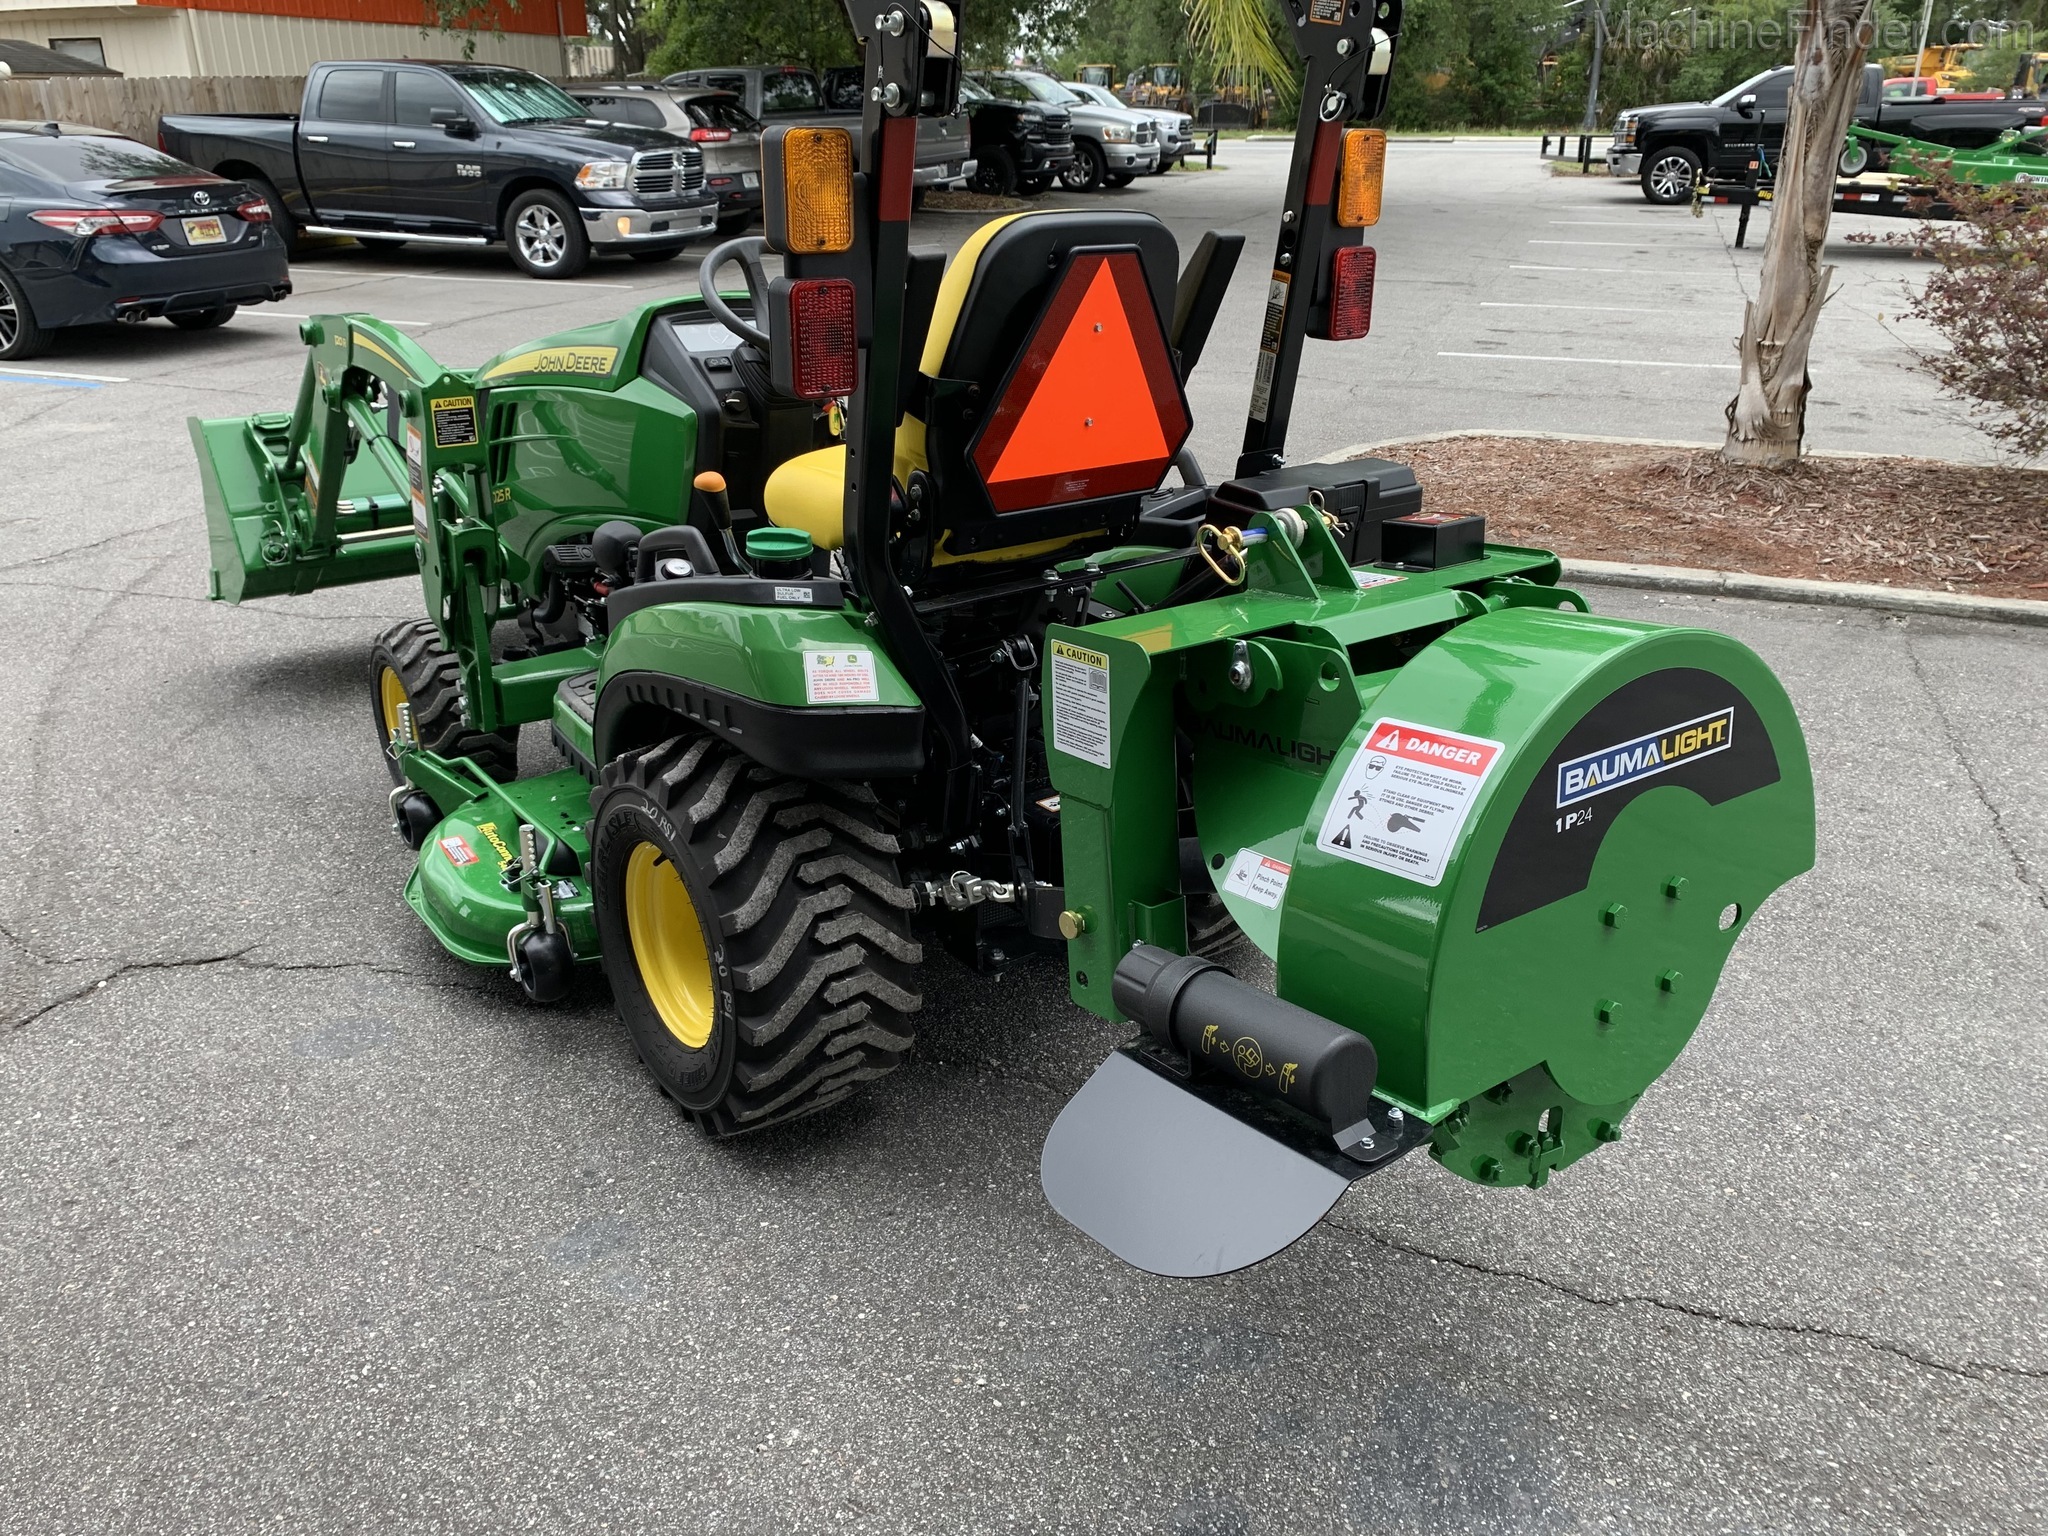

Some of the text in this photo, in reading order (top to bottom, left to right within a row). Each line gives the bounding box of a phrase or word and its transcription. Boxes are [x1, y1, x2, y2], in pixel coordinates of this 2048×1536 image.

[1757, 190, 1773, 200] Big
[534, 352, 608, 372] JOHN DEERE
[443, 398, 472, 408] CAUTION
[1066, 647, 1102, 667] CAUTION
[1186, 714, 1337, 766] BAUMALIGH
[1405, 737, 1483, 766] DANGER
[1565, 719, 1727, 796] BAUMALIGHT
[640, 797, 658, 819] 20
[1252, 883, 1264, 893] Keep
[1256, 873, 1283, 889] Pinch Point.
[713, 943, 728, 978] 20
